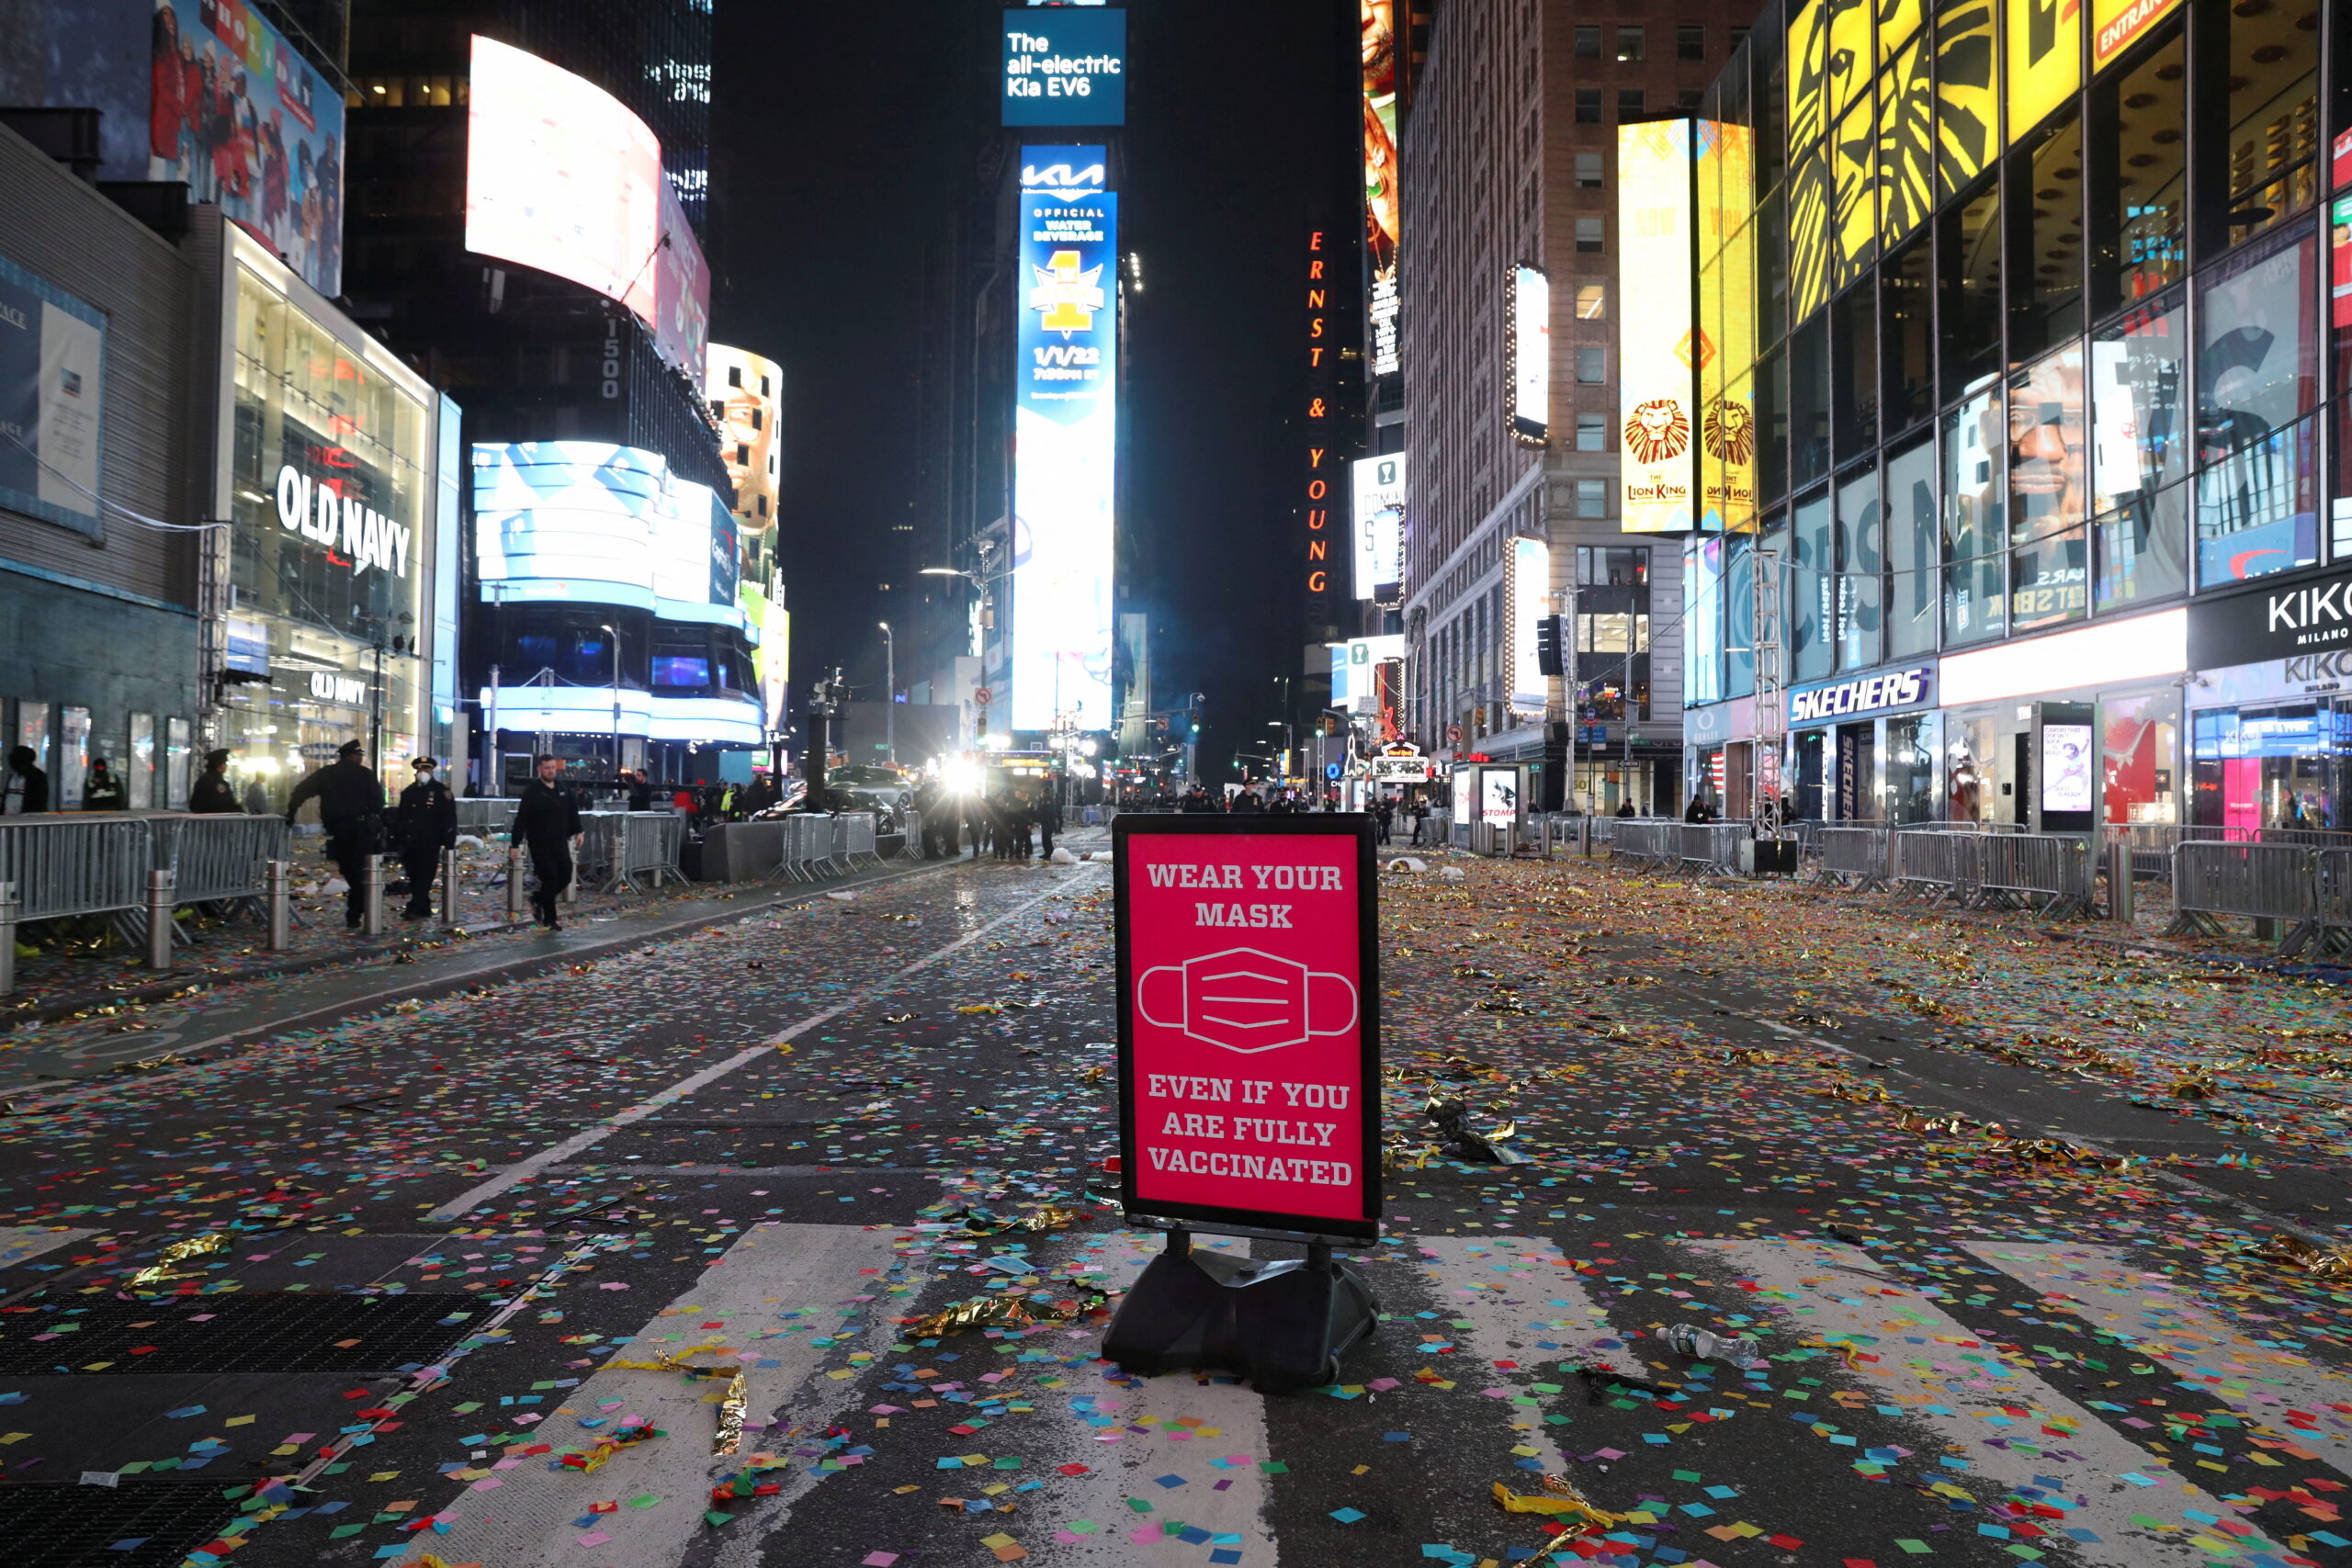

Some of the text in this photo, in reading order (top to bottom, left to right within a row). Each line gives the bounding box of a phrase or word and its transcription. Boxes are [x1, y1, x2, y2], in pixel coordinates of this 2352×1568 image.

[1007, 33, 1049, 52] The
[1007, 54, 1121, 74] all-electric
[1007, 77, 1091, 96] Kia EV6
[1033, 208, 1104, 218] OFFICIAL
[1045, 220, 1092, 231] WATER
[1033, 231, 1104, 242] BEVERAGE
[602, 319, 620, 399] 1500
[1308, 231, 1326, 592] ERNST & YOUNG
[277, 465, 410, 578] OLD NAVY
[2268, 582, 2352, 633] KIK
[2297, 627, 2349, 645] MILANO
[311, 671, 366, 705] OLD NAVY
[1791, 669, 1923, 722] SKECHERS
[1147, 863, 1343, 891] WEAR YOUR
[1194, 902, 1293, 929] MASK
[1148, 1073, 1350, 1110] EVEN IF YOU
[1162, 1112, 1337, 1147] ARE FULLY
[1148, 1146, 1352, 1187] VACCINATED
